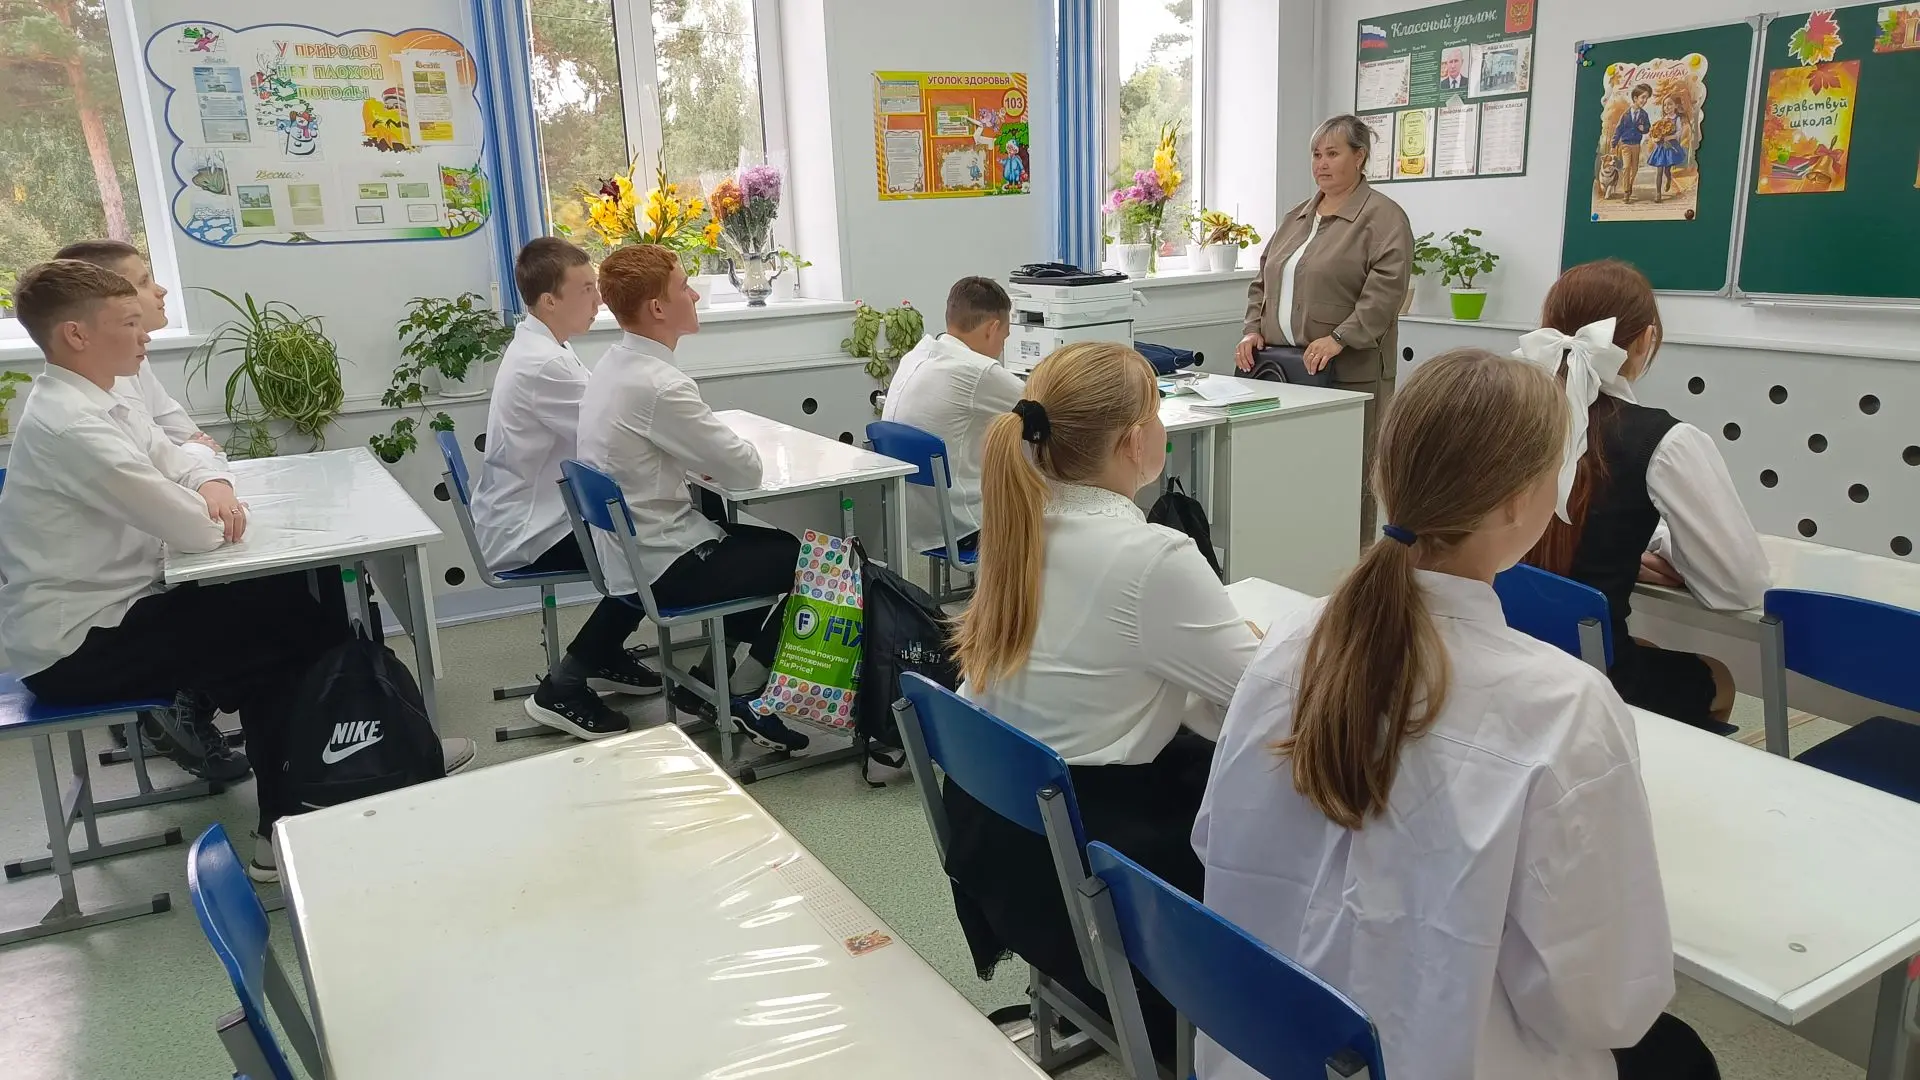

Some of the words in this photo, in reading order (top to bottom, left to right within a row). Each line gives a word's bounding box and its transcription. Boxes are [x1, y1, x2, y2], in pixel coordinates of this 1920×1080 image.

[1391, 13, 1452, 37] Классный
[1454, 10, 1498, 33] уголок
[273, 41, 287, 58] У
[295, 43, 378, 59] ПРИРОДЫ
[277, 64, 308, 79] НЕТ
[313, 63, 384, 80] ПЛОХОЙ
[1618, 67, 1636, 90] 1
[928, 76, 963, 84] УГОЛОК
[964, 76, 1010, 85] ЗДОРОВЬЯ
[297, 84, 370, 101] ПОГОДЫ
[1005, 97, 1023, 109] 103
[1772, 97, 1848, 117] Здравствуй
[1790, 113, 1838, 128] школа!
[798, 613, 810, 630] F
[784, 642, 816, 656] Удобные
[816, 651, 849, 663] покупки
[786, 653, 832, 669] приложении
[779, 660, 790, 668] Fix
[790, 662, 814, 675] Price!
[331, 720, 381, 745] NIKE
